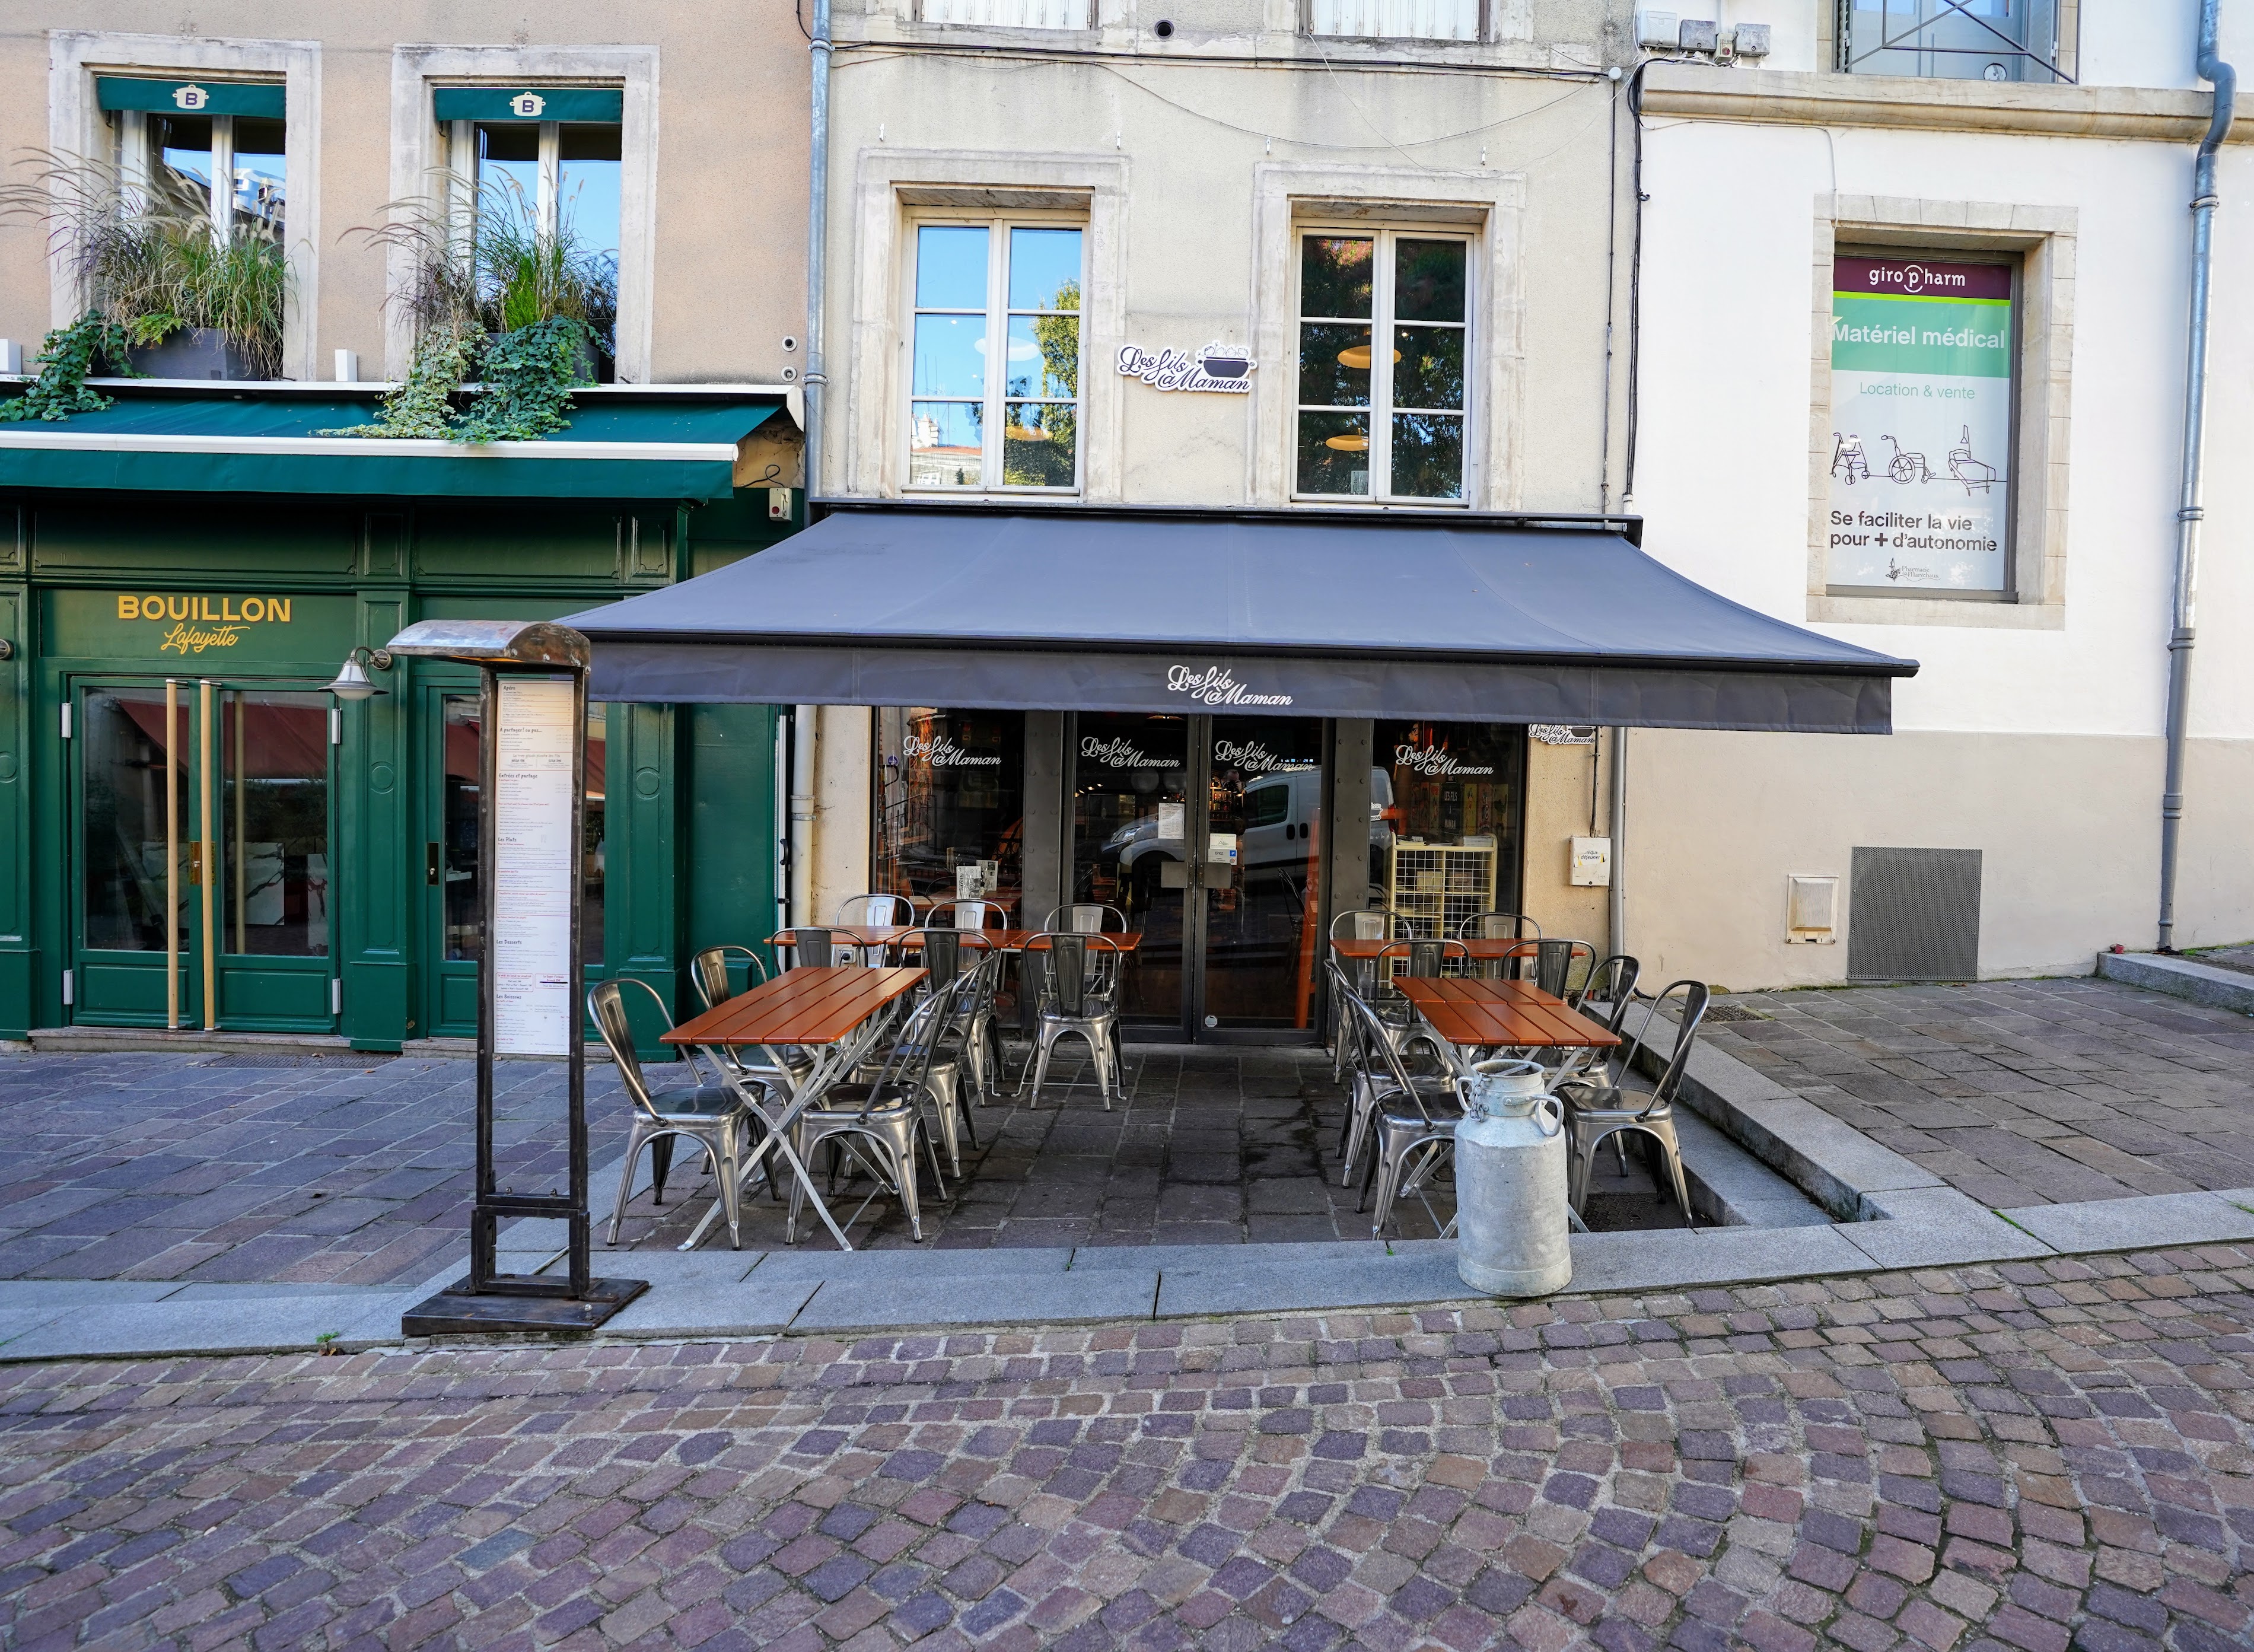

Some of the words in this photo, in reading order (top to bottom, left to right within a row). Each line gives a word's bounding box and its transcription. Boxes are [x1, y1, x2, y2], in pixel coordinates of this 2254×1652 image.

[186, 93, 198, 105] B
[522, 100, 534, 112] B
[1869, 266, 1966, 288] giropharm
[1832, 324, 1915, 345] Matériel
[1922, 327, 2004, 348] médical
[1119, 346, 1157, 373] Les
[1144, 349, 1188, 381] fils
[1175, 367, 1250, 390] Maman
[1860, 382, 1918, 396] Location
[1924, 385, 1933, 397] &
[1937, 387, 1975, 399] vente
[1830, 510, 1853, 526] Se
[1858, 511, 1922, 529] faciliter
[1928, 514, 1941, 529] la
[1948, 515, 1972, 530] vie
[1830, 533, 1870, 549] pour
[1874, 533, 1888, 547] +
[119, 596, 291, 622] BOUILLON
[161, 623, 250, 654] Lafayette
[1167, 664, 1204, 692] Les
[1190, 666, 1234, 699] fils
[1222, 684, 1293, 705] Maman
[1530, 724, 1549, 736] Les
[1542, 724, 1564, 740] fils
[1558, 732, 1594, 743] Maman
[903, 736, 932, 756] Les
[921, 735, 955, 762] fils
[947, 749, 1002, 766] Maman
[1081, 736, 1110, 757] Les
[1100, 737, 1134, 763] fils
[1215, 740, 1244, 761] Les
[1233, 741, 1268, 766] fils
[1396, 744, 1424, 765] Les
[1413, 744, 1447, 771] fils
[1126, 750, 1180, 768] Maman
[1260, 755, 1316, 771] Maman
[1440, 758, 1494, 775] Maman
[1444, 819, 1456, 830] MAMAN
